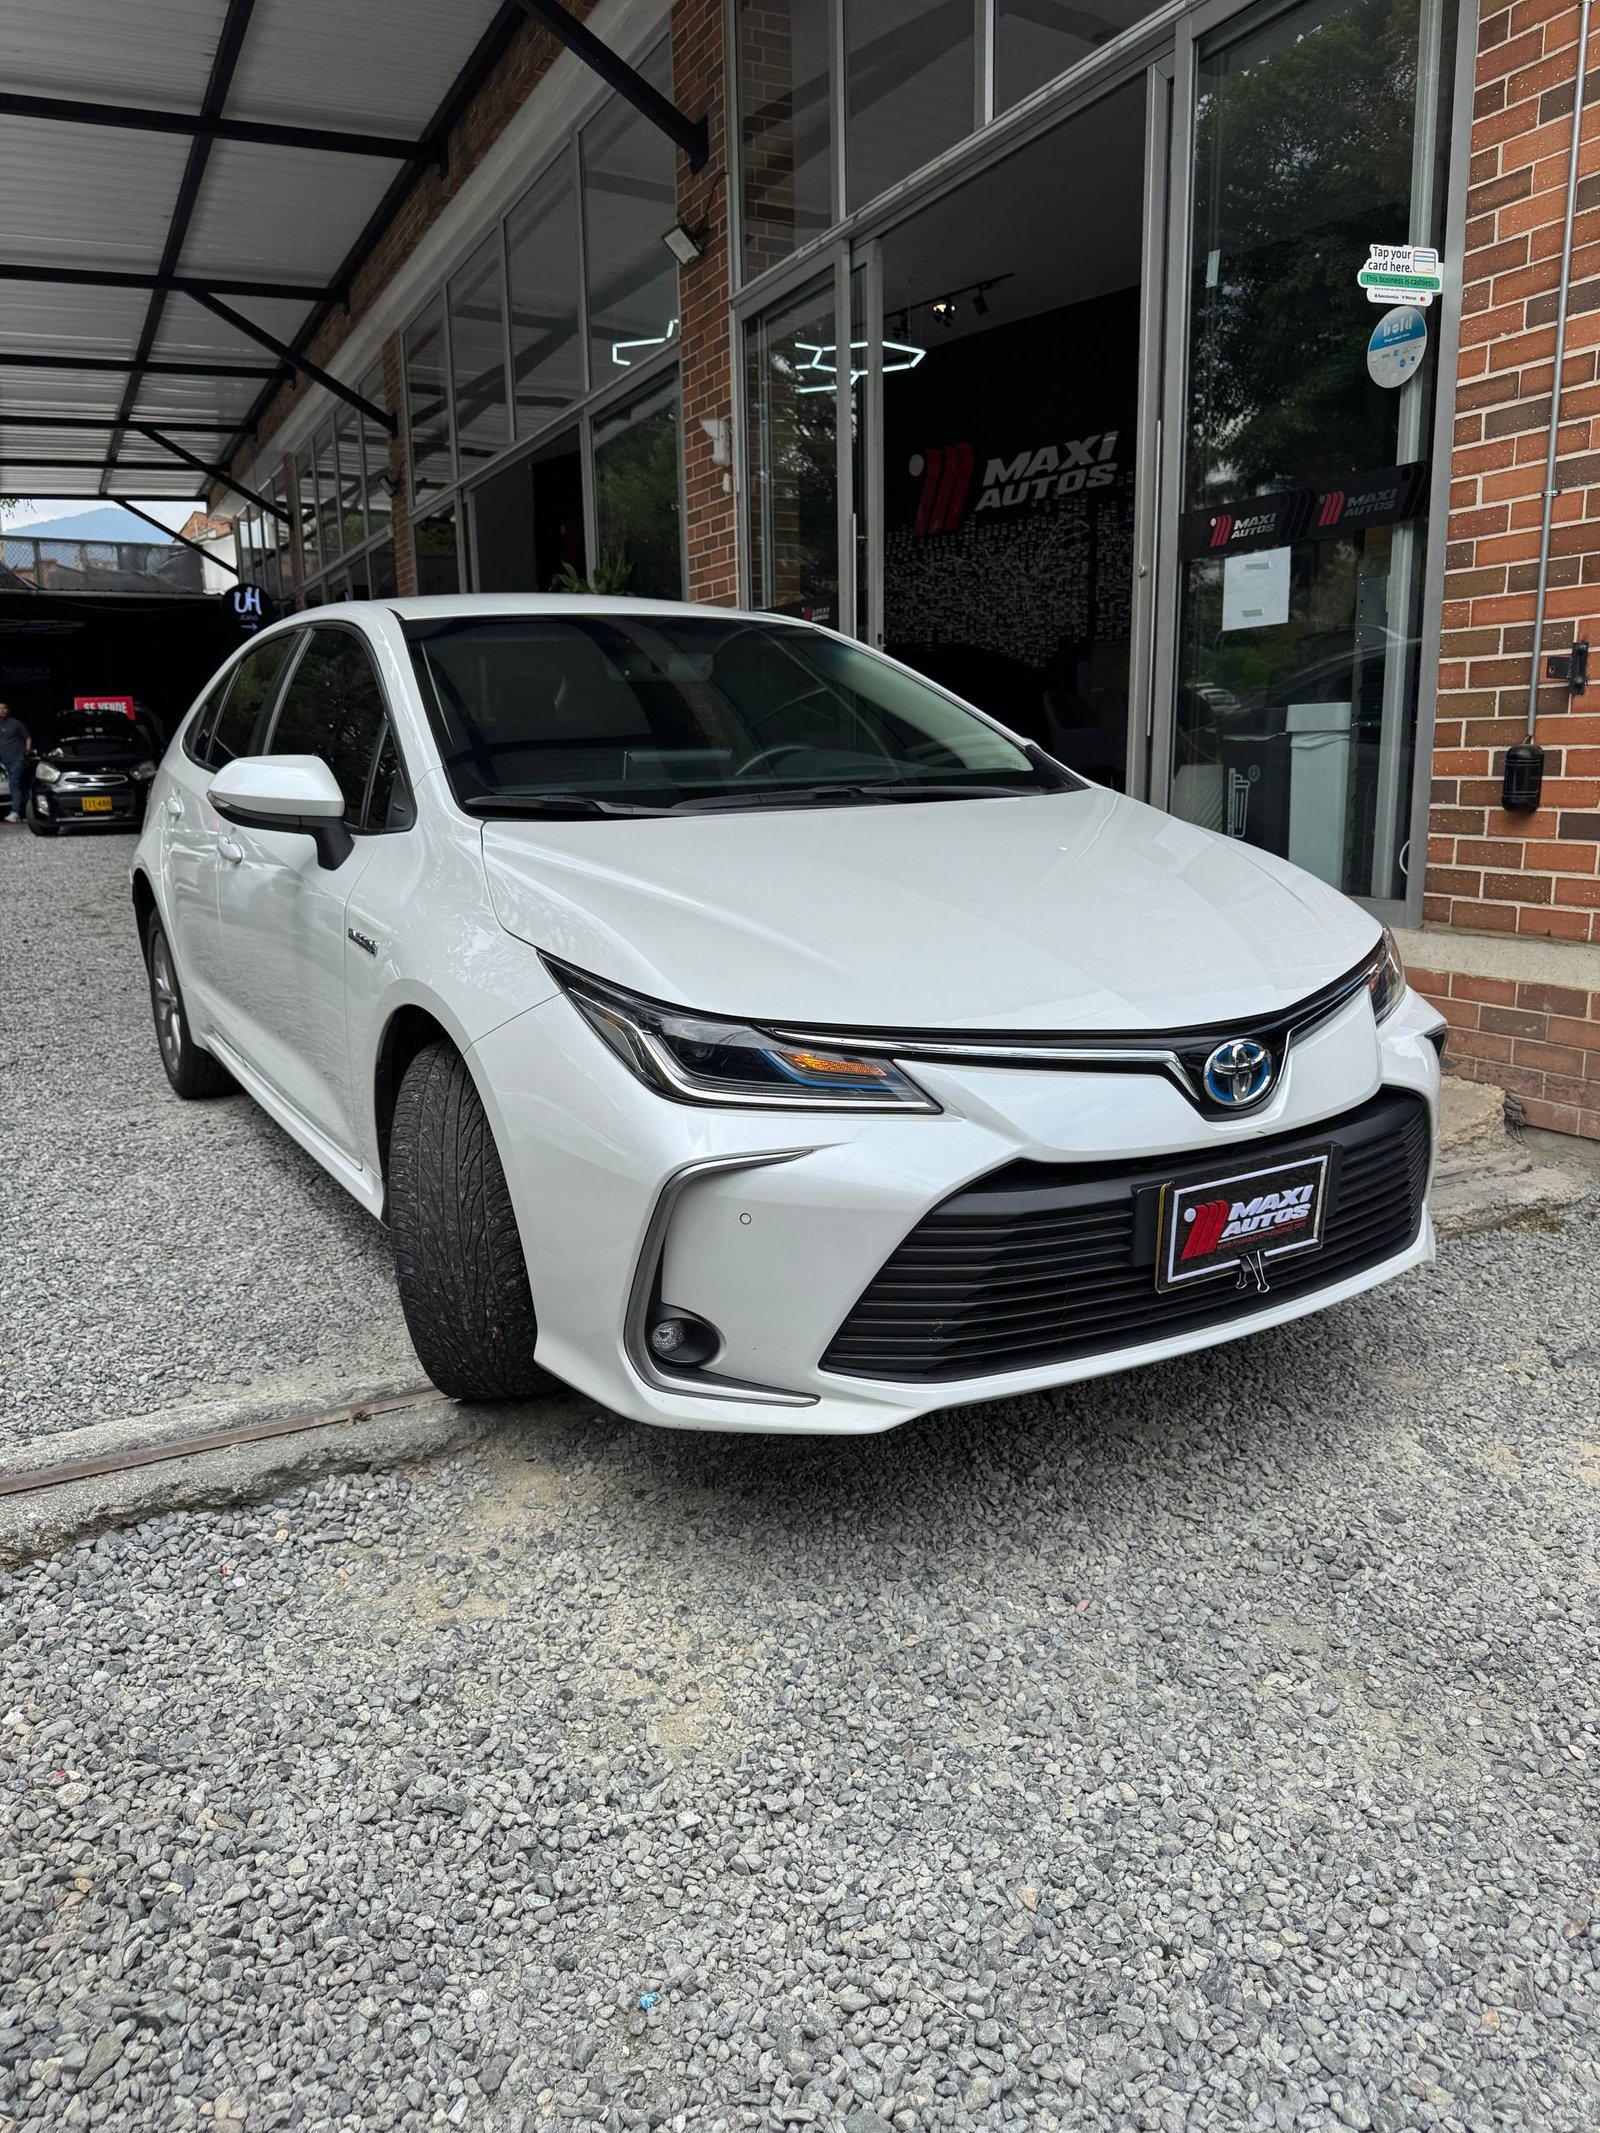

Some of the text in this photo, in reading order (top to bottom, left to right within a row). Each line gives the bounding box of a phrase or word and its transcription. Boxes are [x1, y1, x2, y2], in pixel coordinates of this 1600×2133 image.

[1373, 246, 1411, 260] Tap your
[1368, 260, 1412, 273] card here.
[1366, 274, 1378, 283] This
[1379, 276, 1404, 285] business
[1405, 278, 1410, 286] is
[1383, 315, 1413, 337] bold
[982, 430, 1119, 487] MAXI
[974, 462, 1118, 512] AUTOS
[1347, 488, 1398, 508] MAXI
[1343, 500, 1396, 518] AUTOS
[1230, 523, 1275, 539] AUTOS
[1233, 512, 1277, 531] MAXI
[233, 586, 262, 616] UH
[97, 702, 128, 714] VENDE
[1228, 1184, 1315, 1221] MAXI
[1221, 1203, 1311, 1238] AUTOS
